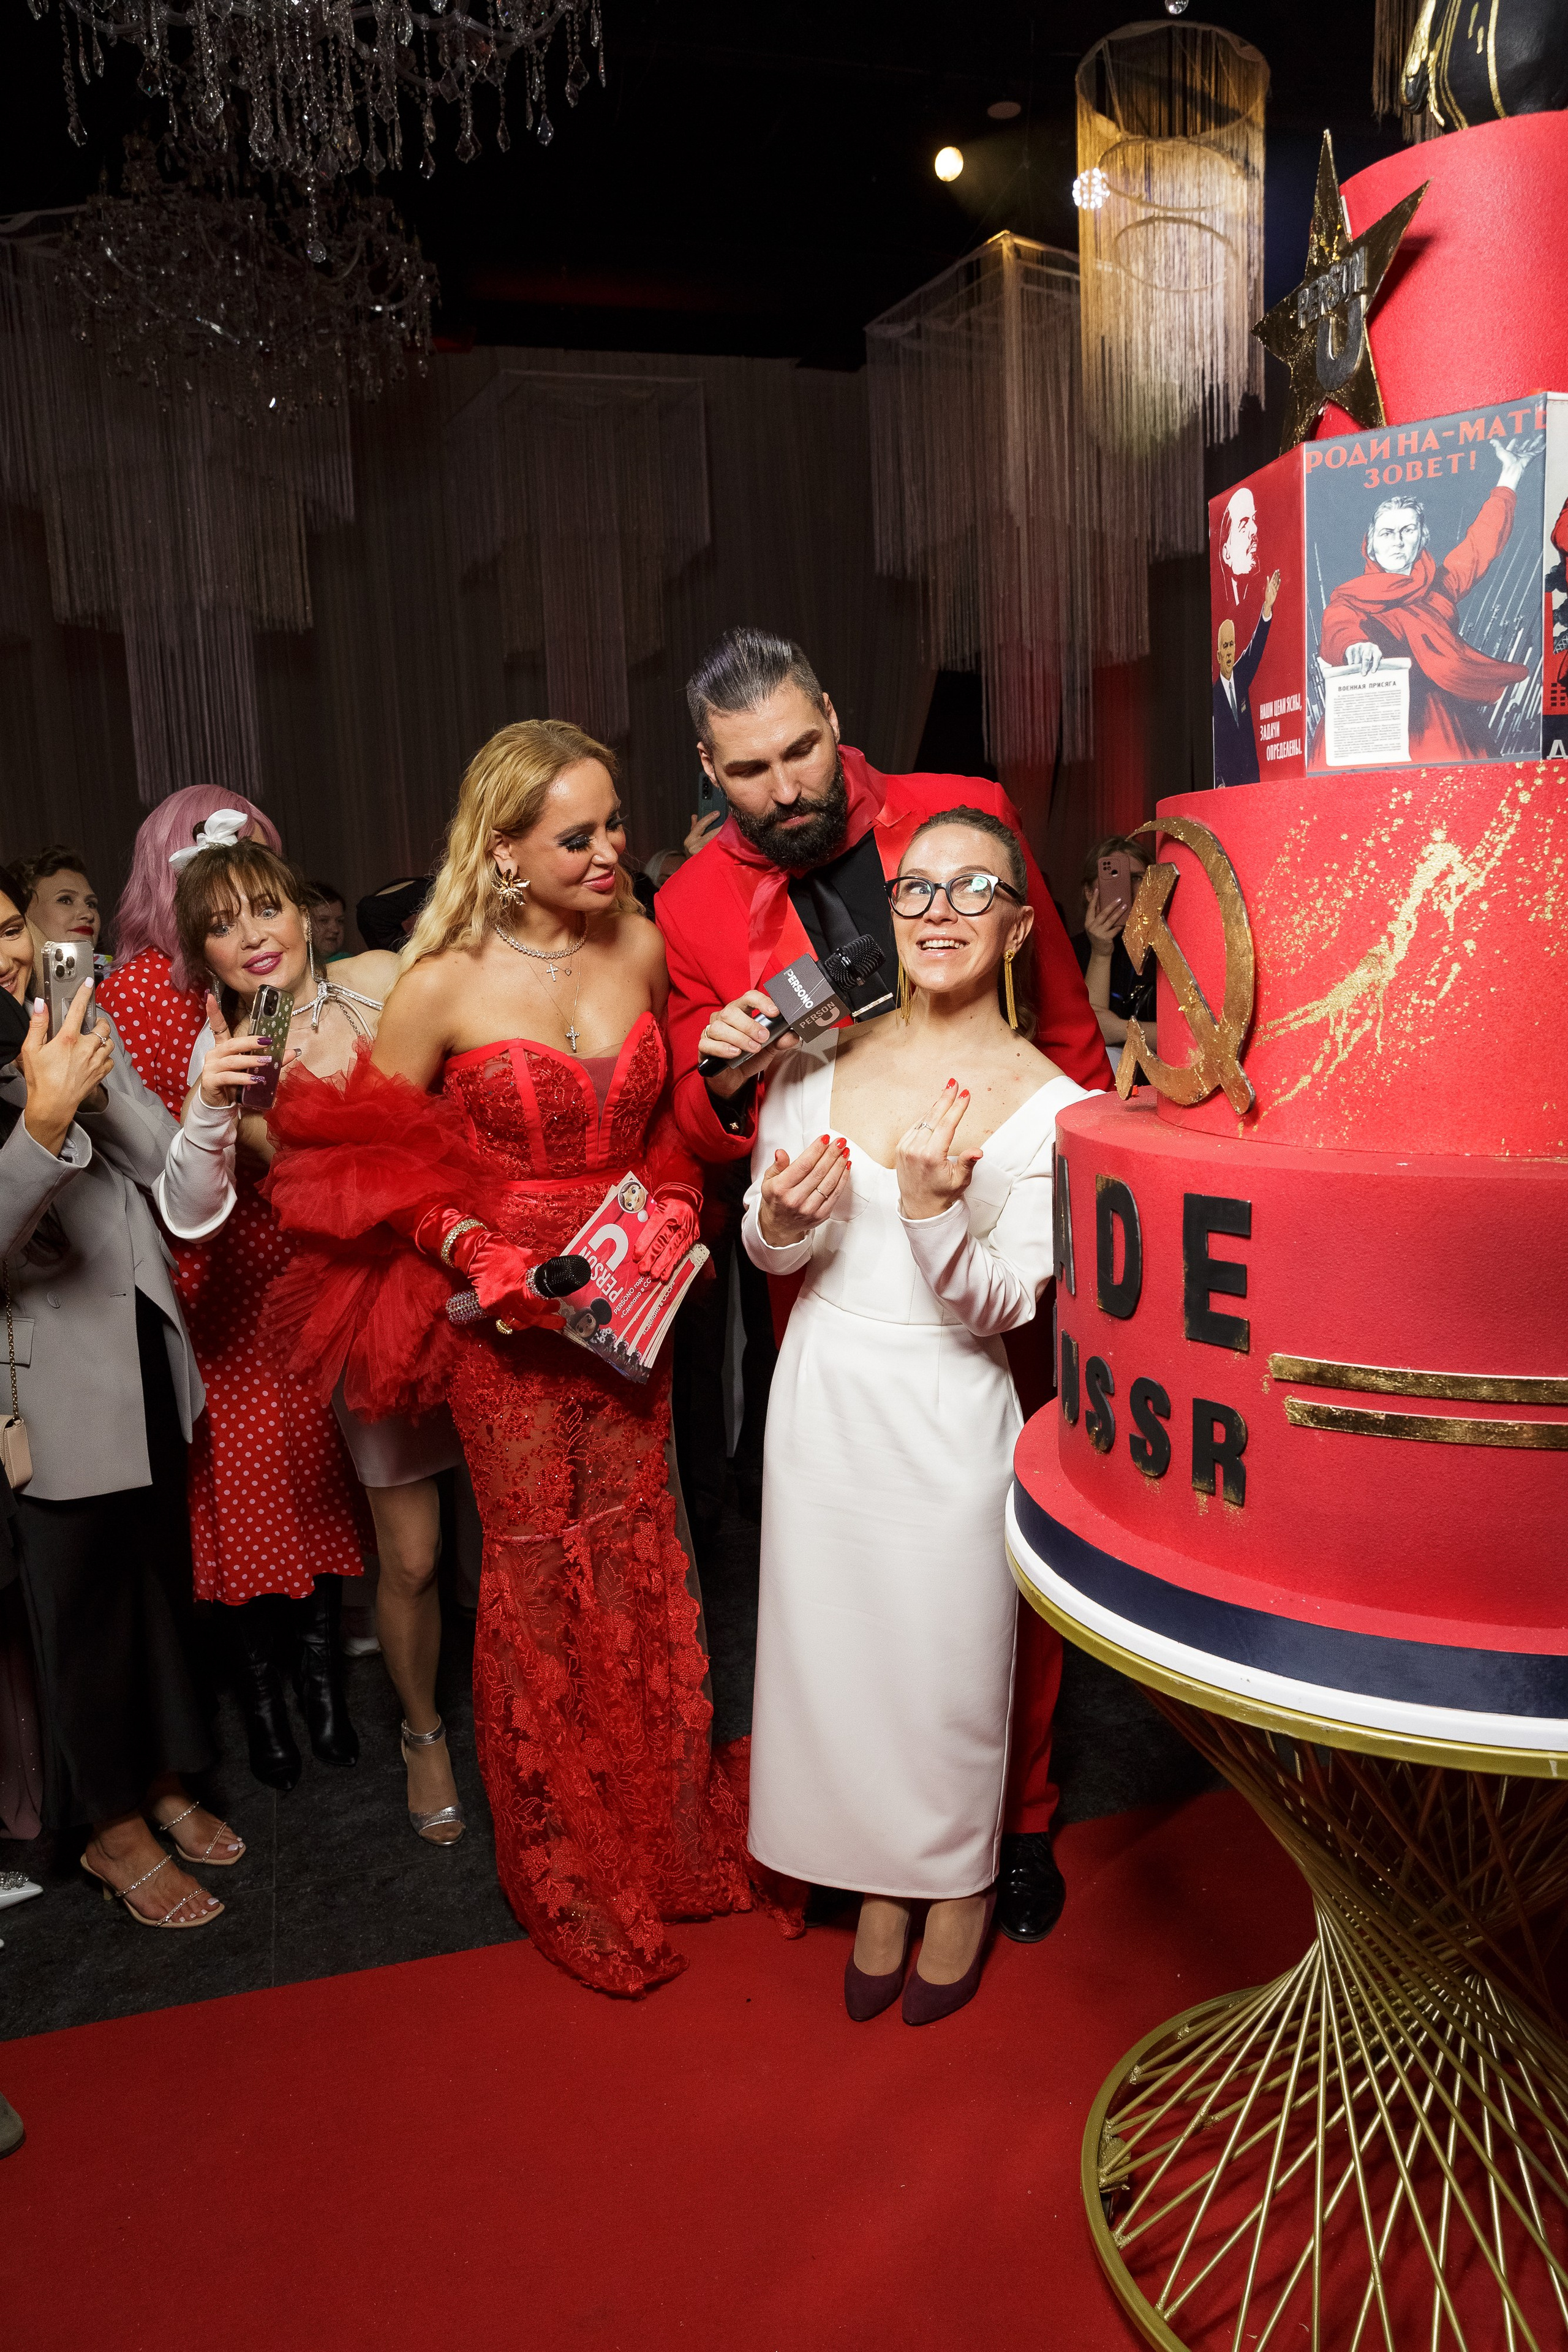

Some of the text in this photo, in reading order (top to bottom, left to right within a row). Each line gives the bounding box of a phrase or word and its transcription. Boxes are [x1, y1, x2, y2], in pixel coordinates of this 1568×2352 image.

[1363, 451, 1476, 489] ЗОВЕТ!
[1260, 693, 1302, 720] НАШИ ЦЕЛИ ЯСНЫ,
[1260, 721, 1280, 741] ЗАДАЧИ
[1266, 738, 1302, 761] ОПРЕДЕЛЕНЫ.
[799, 1001, 835, 1028] PERSON
[613, 1287, 635, 1315] PERSONO
[620, 1291, 641, 1319] «Сделано
